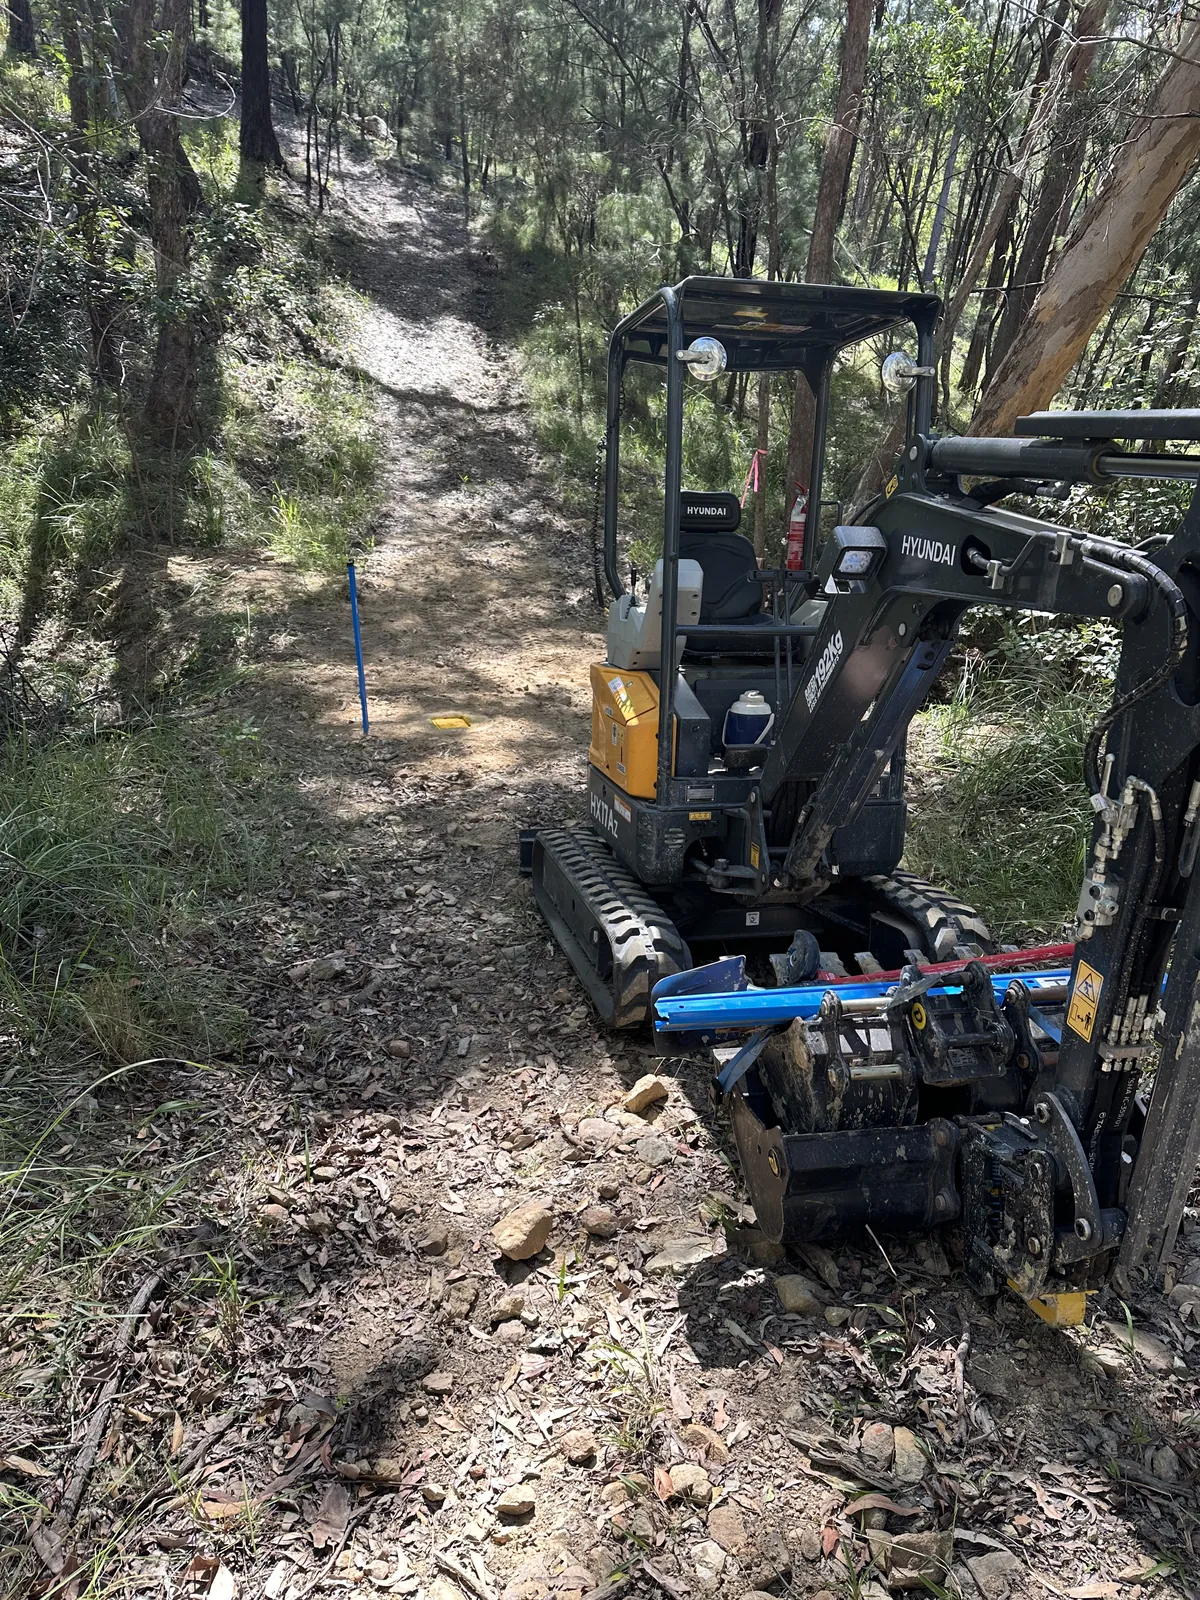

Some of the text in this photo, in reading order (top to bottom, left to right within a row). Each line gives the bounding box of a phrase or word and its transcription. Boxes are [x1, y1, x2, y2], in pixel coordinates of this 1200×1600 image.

[687, 506, 727, 516] HYUNDAI
[901, 534, 956, 566] HYUNDAI
[815, 629, 843, 687] 192Kg
